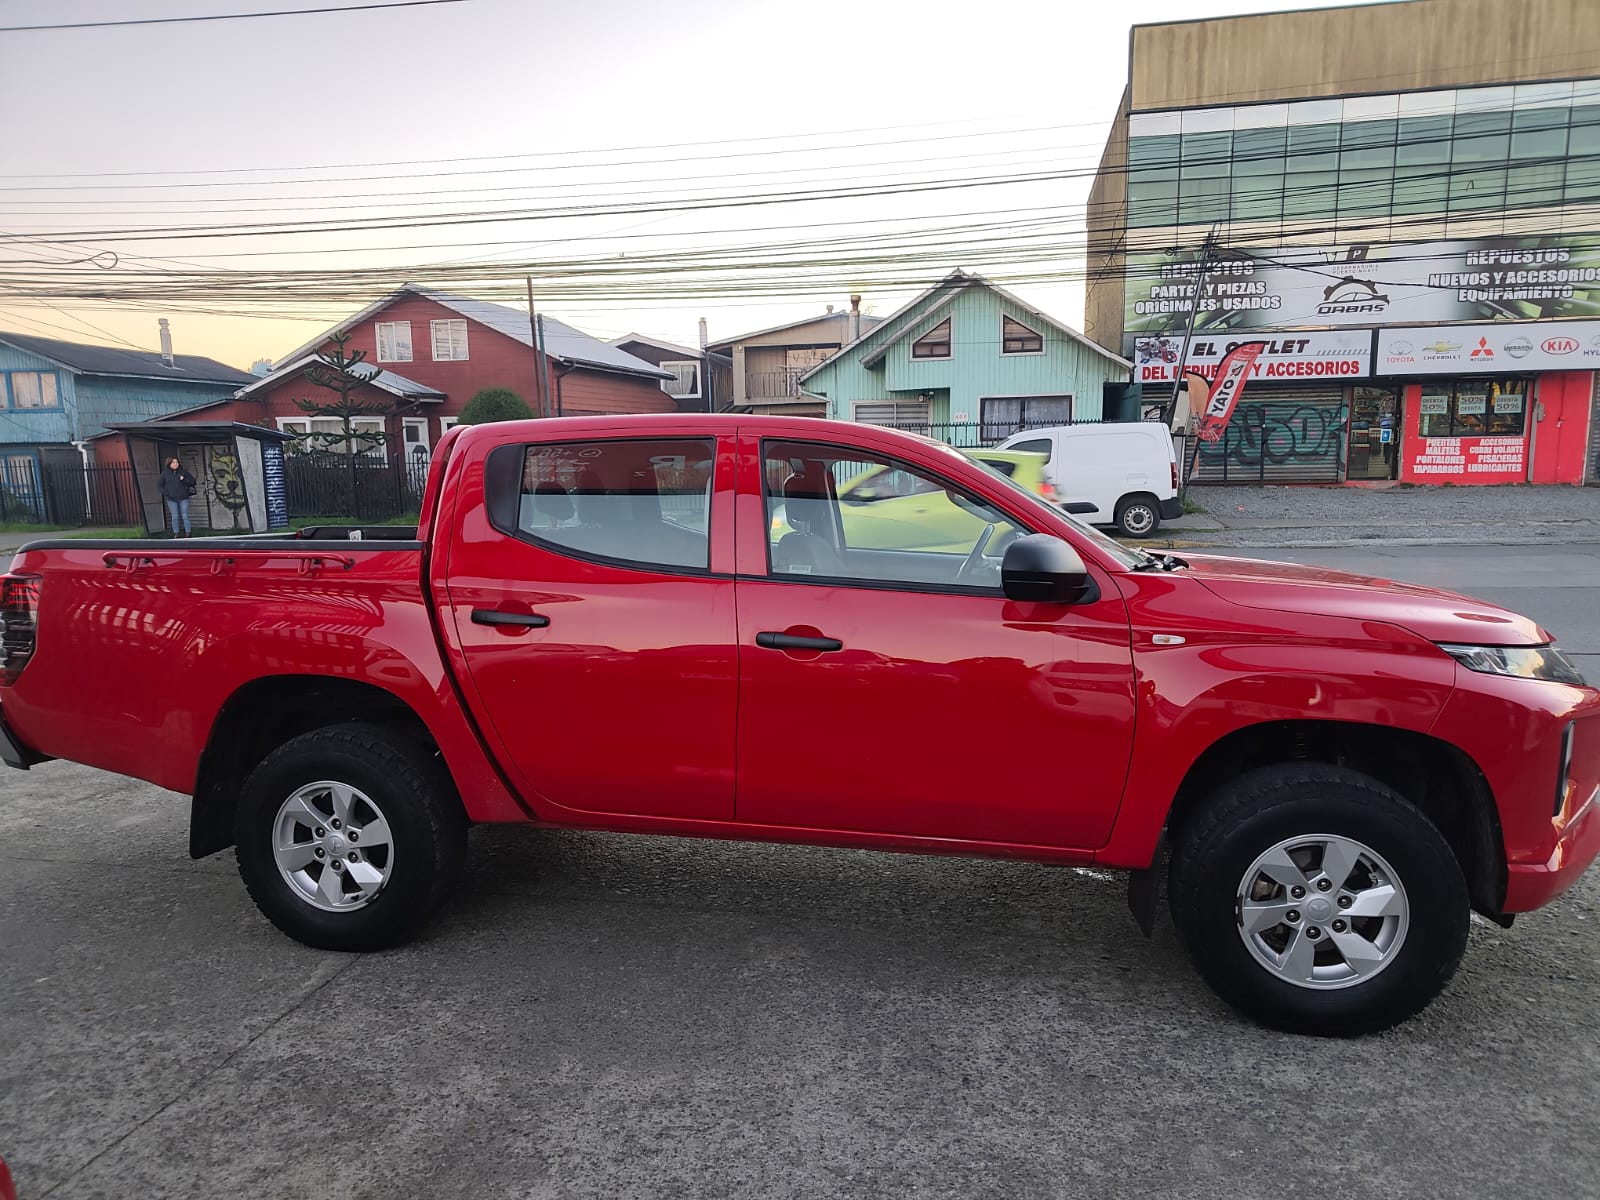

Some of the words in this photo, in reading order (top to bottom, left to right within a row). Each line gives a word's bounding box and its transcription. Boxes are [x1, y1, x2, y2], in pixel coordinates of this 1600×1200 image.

[1466, 248, 1570, 265] REPUESTOS
[1161, 261, 1254, 279] REPUSTOS
[1206, 284, 1215, 296] Y
[1217, 281, 1266, 296] PIEZAS
[1429, 272, 1490, 288] NUEVOS
[1493, 272, 1504, 285] Y
[1458, 285, 1574, 302] EQUIPAMIENTO
[1135, 298, 1217, 314] ORIGINAES
[1222, 296, 1281, 310] USADOS
[1192, 343, 1217, 356] EL
[1226, 339, 1310, 355] OTLET
[1547, 341, 1573, 351] KIA
[1142, 366, 1169, 380] DEL
[1266, 361, 1360, 377] ACCESORIOS
[1212, 380, 1235, 417] YATO
[1425, 447, 1460, 455] MALETAS
